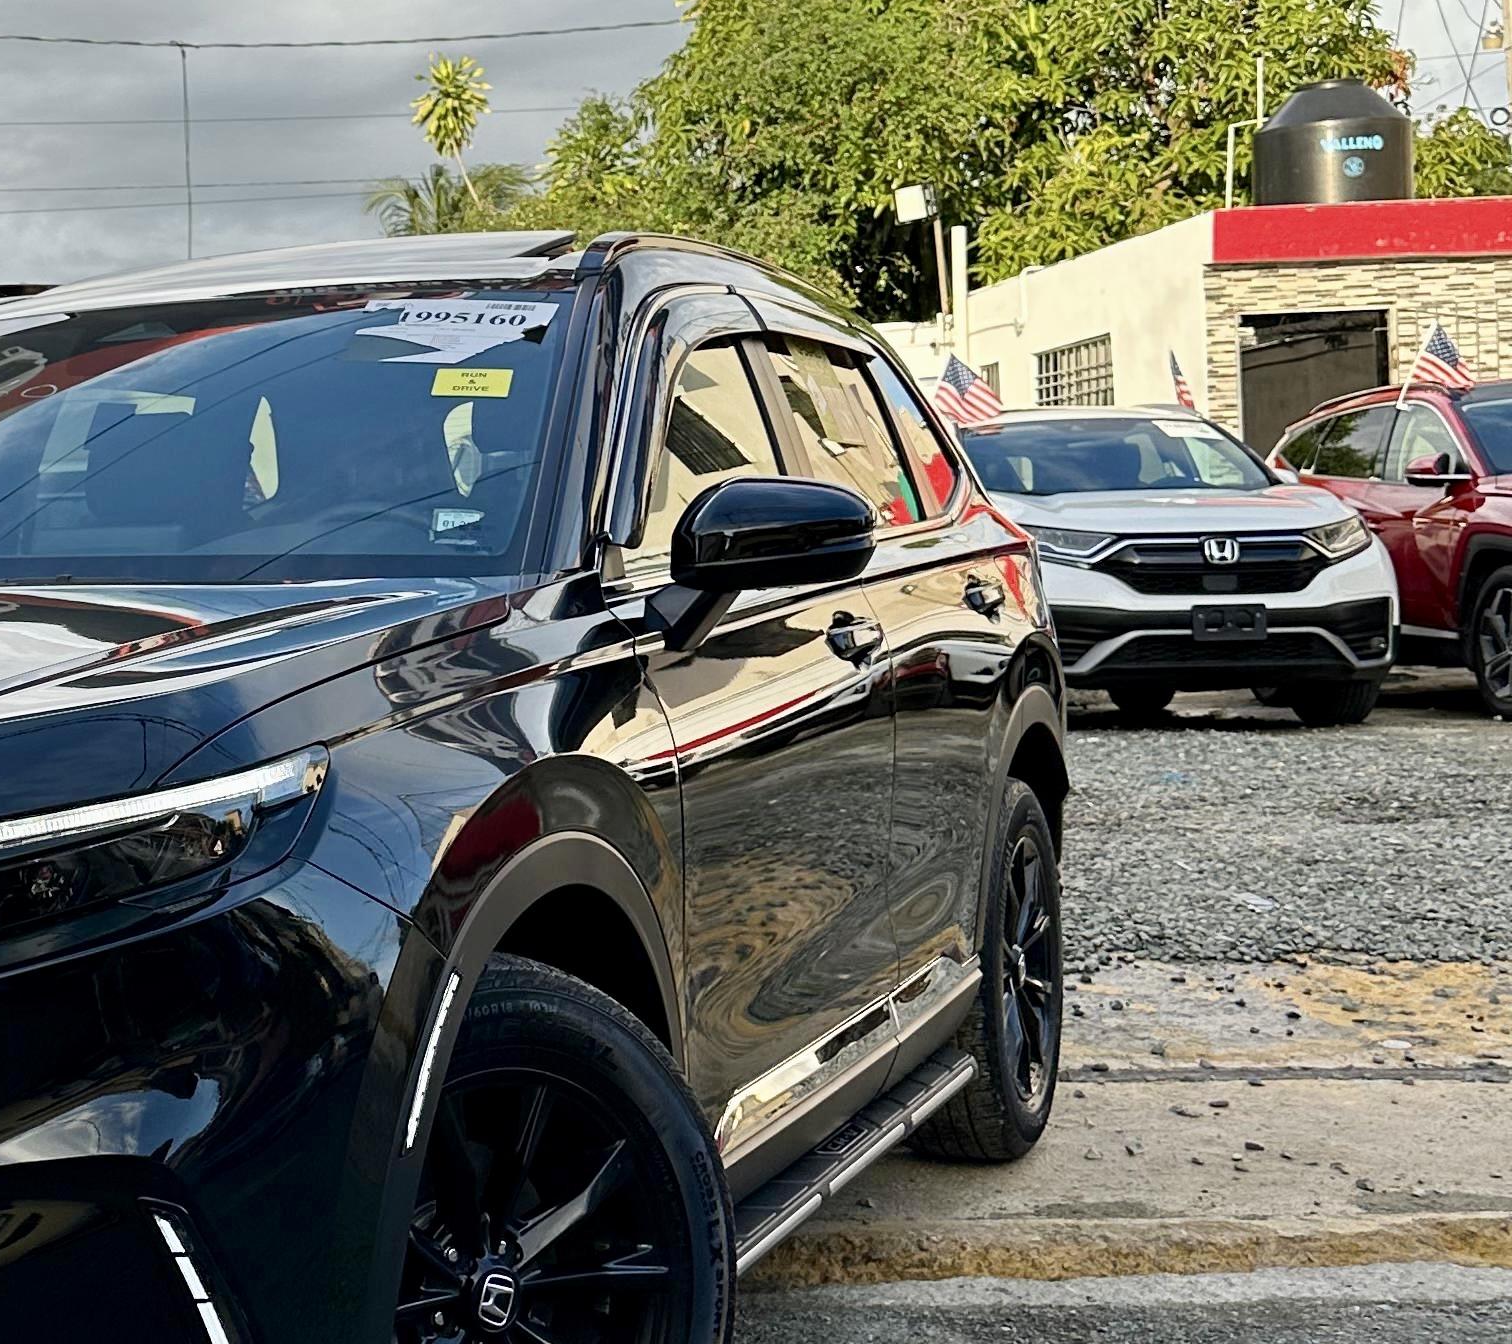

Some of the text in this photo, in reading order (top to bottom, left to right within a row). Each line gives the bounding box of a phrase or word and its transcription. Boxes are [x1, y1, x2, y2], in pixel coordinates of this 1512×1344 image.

[400, 311, 527, 326] 1995160
[828, 1129, 858, 1151] CR-V
[707, 1218, 724, 1267] LX
[713, 1268, 724, 1337] SPORT
